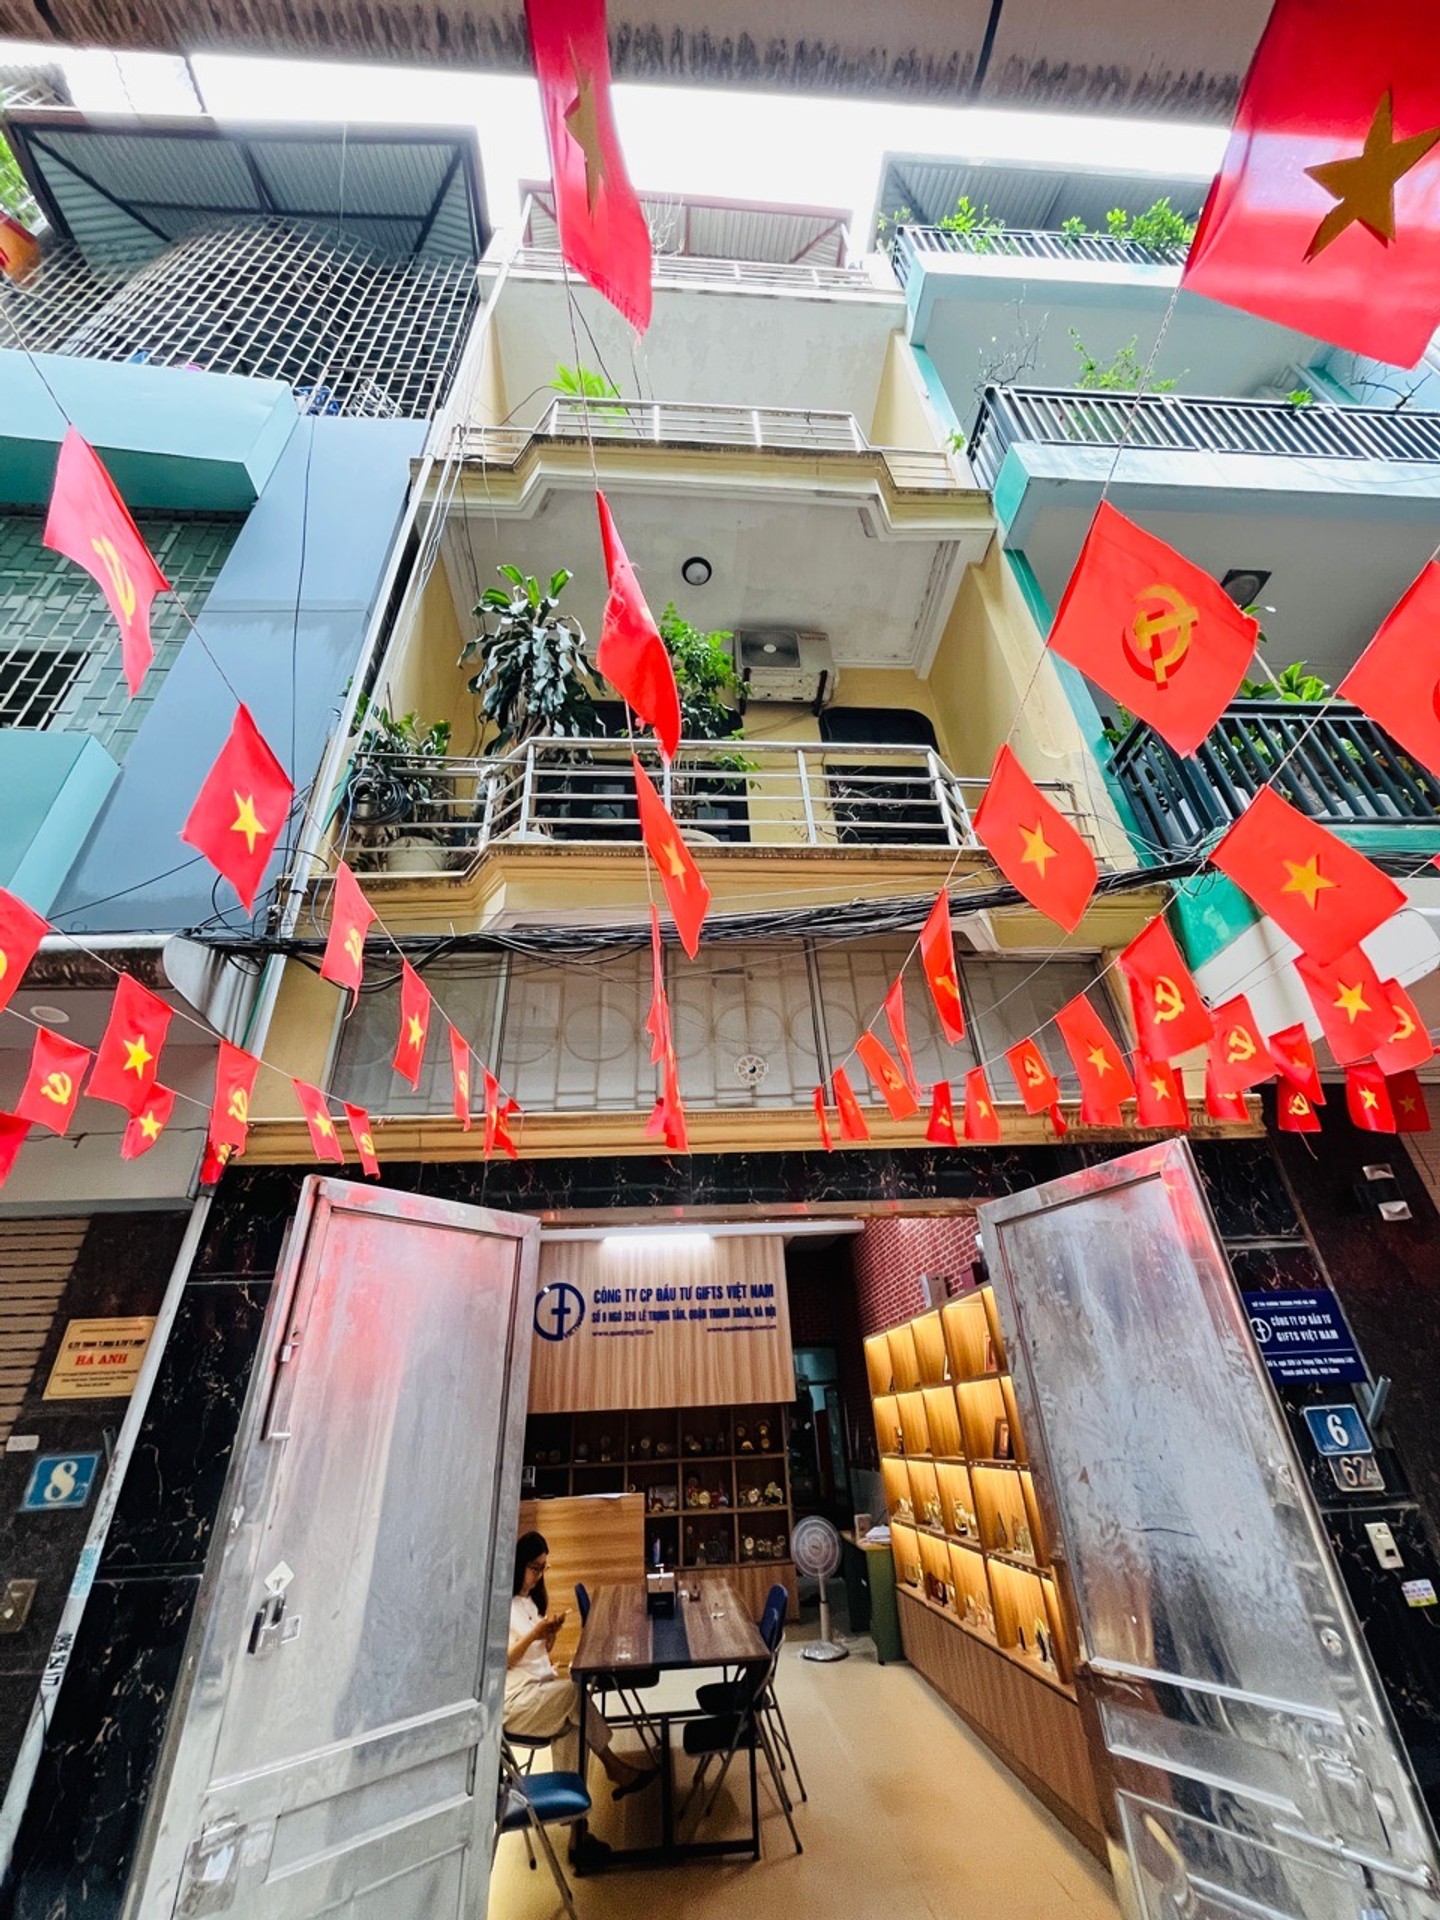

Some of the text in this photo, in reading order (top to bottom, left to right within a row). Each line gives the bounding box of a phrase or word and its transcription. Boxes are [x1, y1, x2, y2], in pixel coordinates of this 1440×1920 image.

[593, 1286, 622, 1303] CÔNG
[625, 1288, 637, 1302] TY
[640, 1288, 653, 1302] CP
[696, 1285, 724, 1300] GIFTS
[726, 1281, 747, 1302] VIỆT
[750, 1284, 774, 1298] NAM
[97, 1353, 129, 1365] ANH
[1326, 1414, 1349, 1448] 6
[44, 1460, 79, 1502] 8
